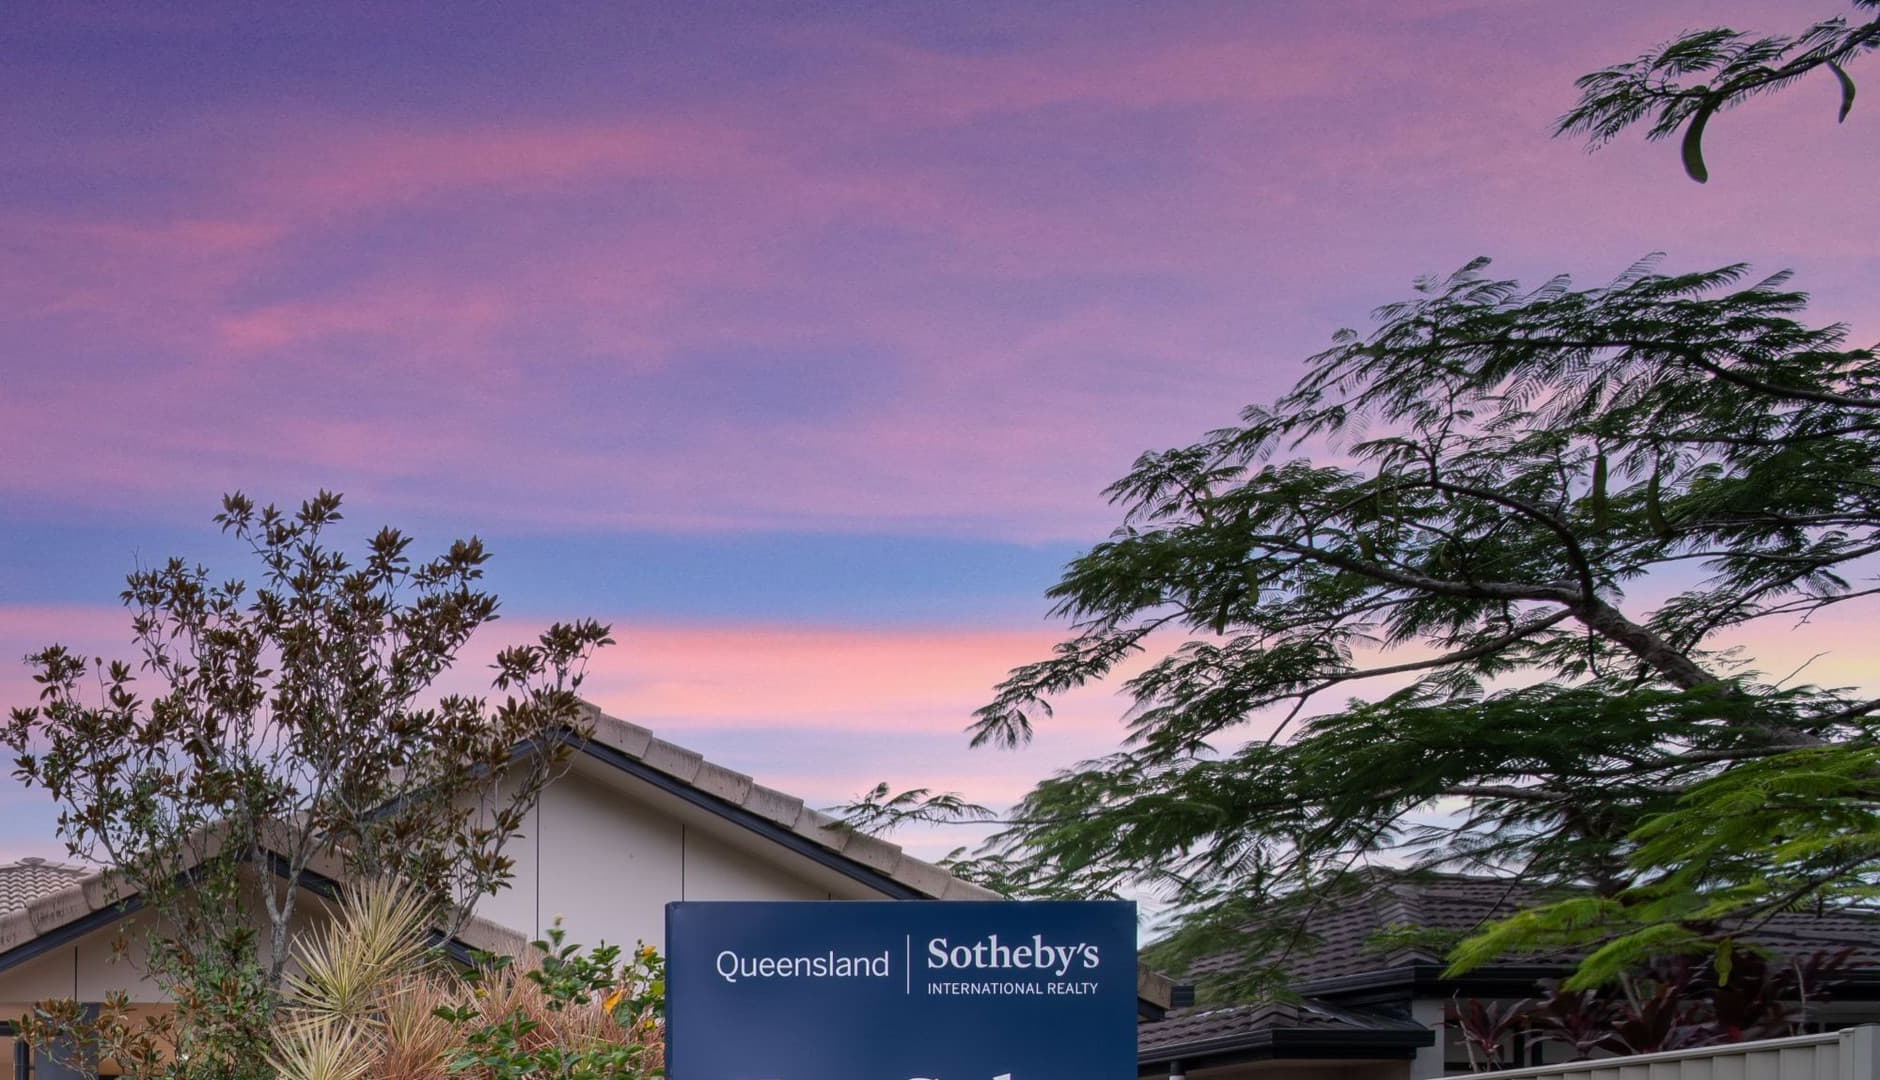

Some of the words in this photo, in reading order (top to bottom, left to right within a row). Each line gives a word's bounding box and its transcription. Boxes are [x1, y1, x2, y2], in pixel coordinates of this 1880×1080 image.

[717, 950, 889, 983] Queensland
[927, 934, 1100, 976] Sotheby's
[927, 982, 1043, 995] INTERNATIONAL
[1047, 982, 1099, 995] REALTY
